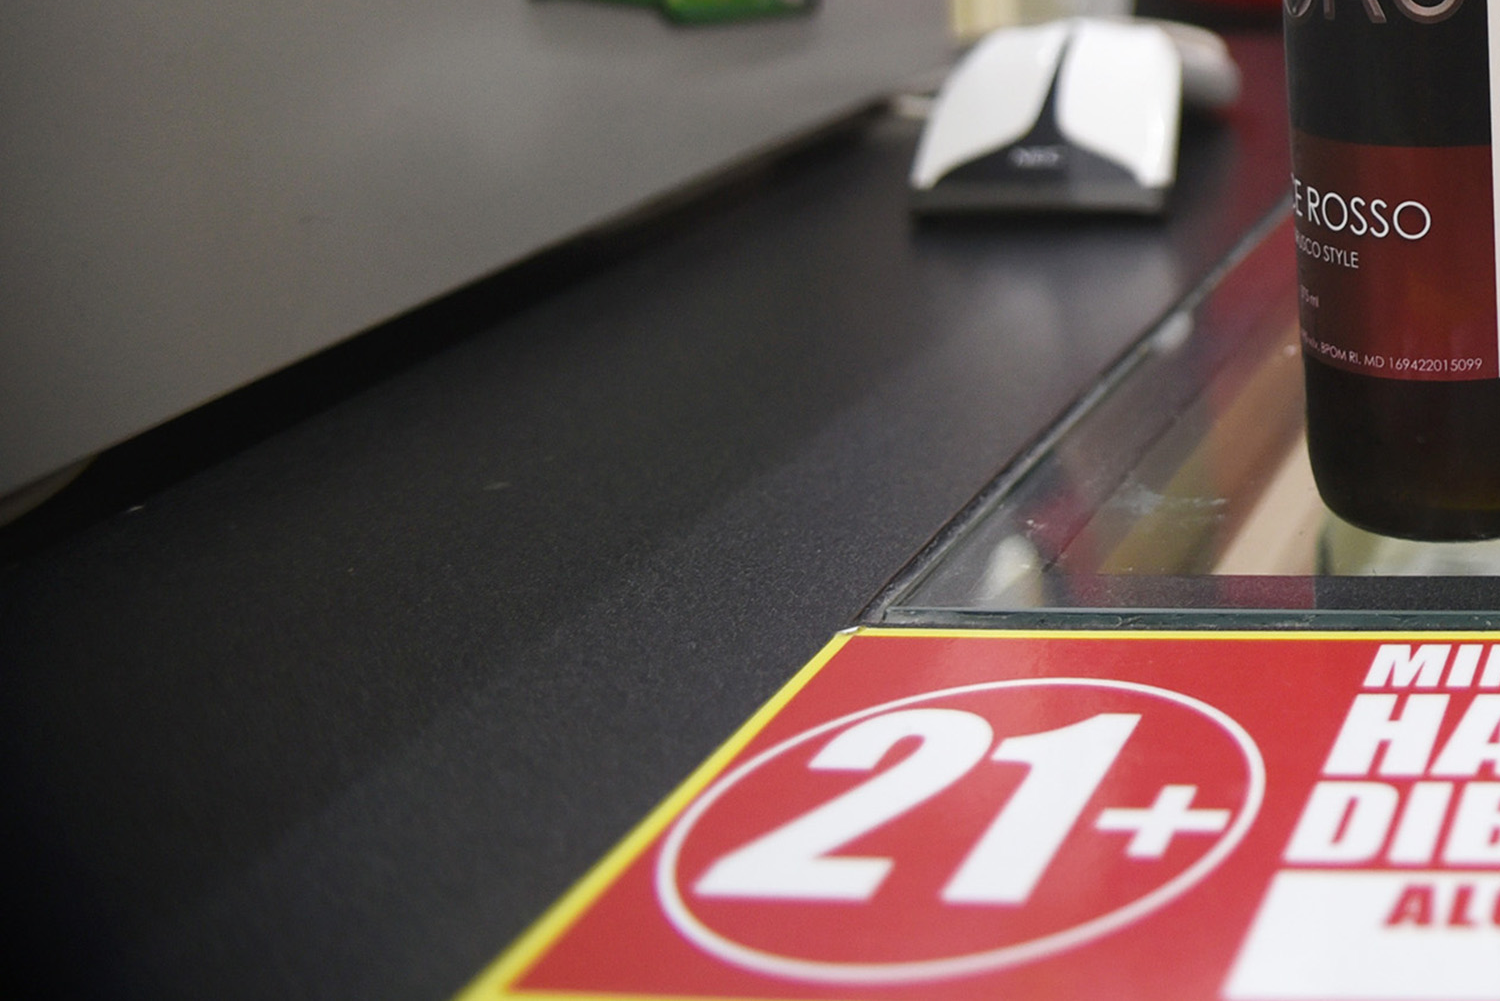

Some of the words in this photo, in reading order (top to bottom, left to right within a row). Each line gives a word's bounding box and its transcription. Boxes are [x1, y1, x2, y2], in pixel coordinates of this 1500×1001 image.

[1307, 186, 1432, 240] ROSSO
[1323, 244, 1360, 268] STYLE
[1364, 355, 1385, 368] MD
[1389, 357, 1482, 372] 169422015099
[692, 707, 1230, 905] 21+
